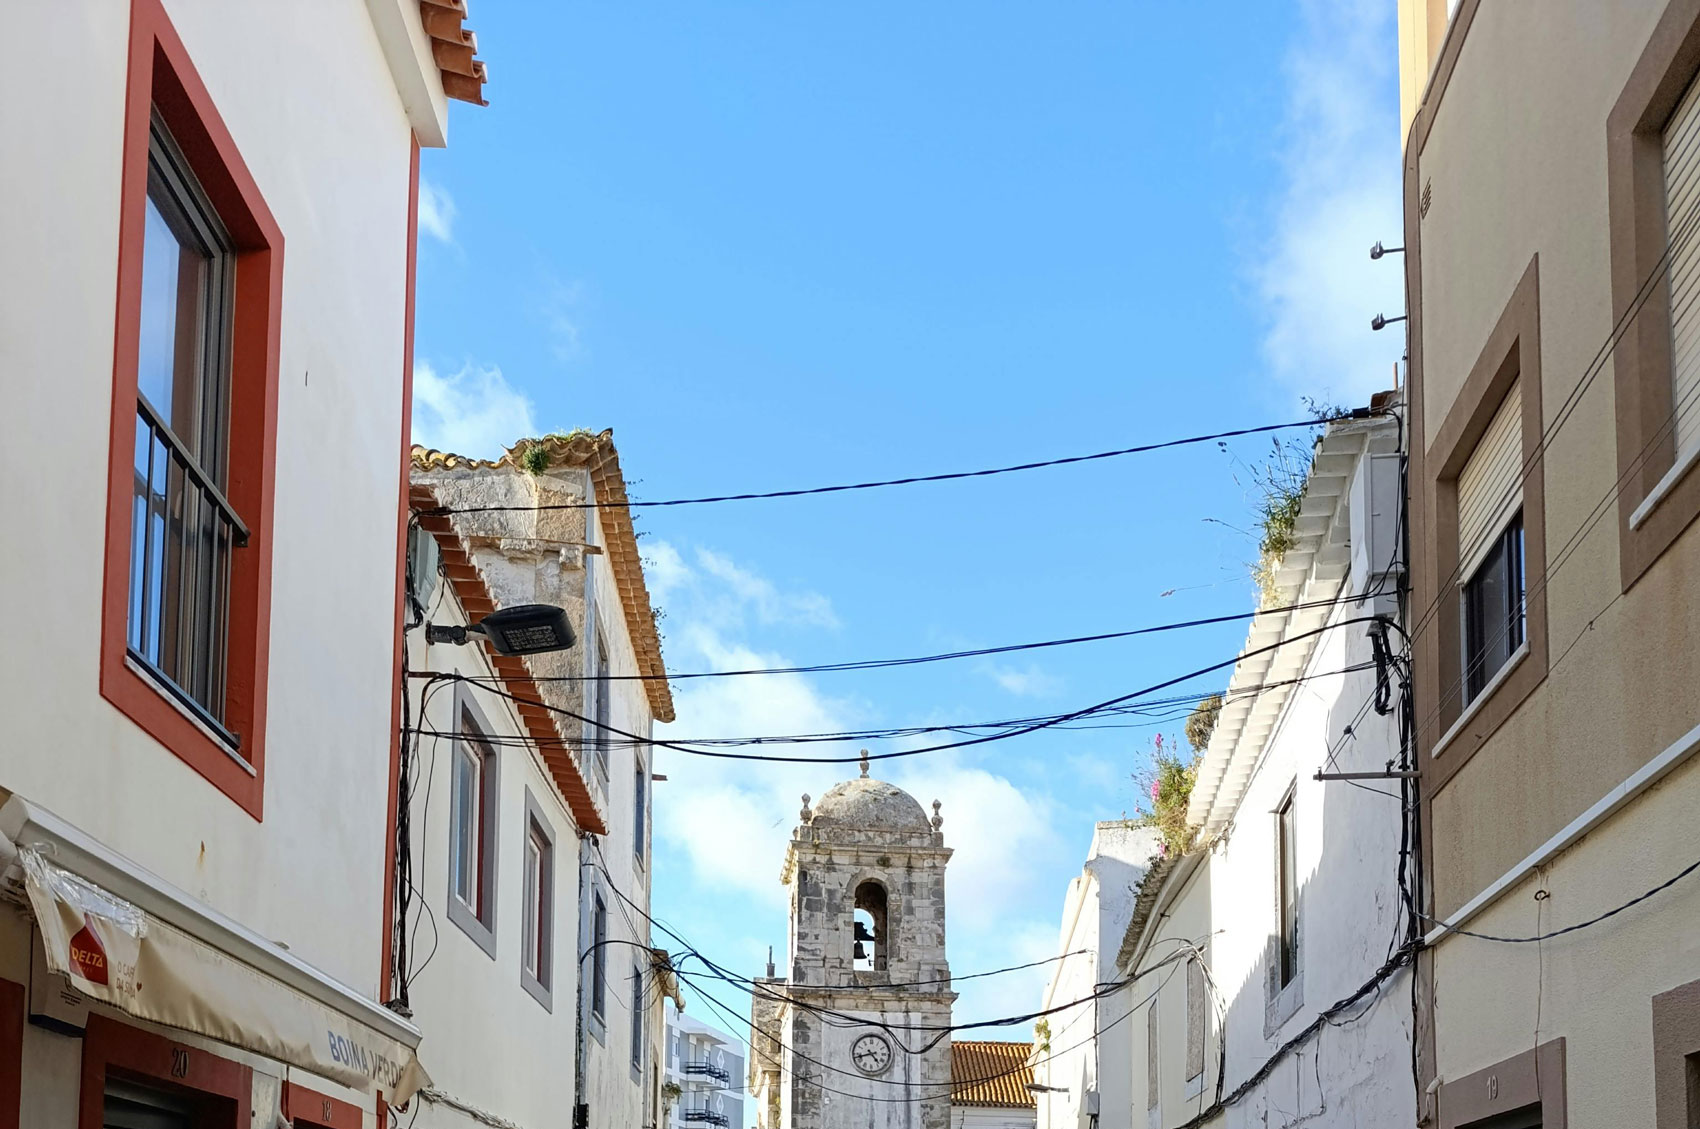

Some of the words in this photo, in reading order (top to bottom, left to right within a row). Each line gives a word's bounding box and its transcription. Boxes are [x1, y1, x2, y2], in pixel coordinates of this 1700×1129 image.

[72, 947, 104, 968] DELTA
[171, 1047, 189, 1078] 20
[327, 1030, 370, 1077] BOINA
[1486, 1075, 1499, 1100] 19
[321, 1100, 332, 1122] 18
